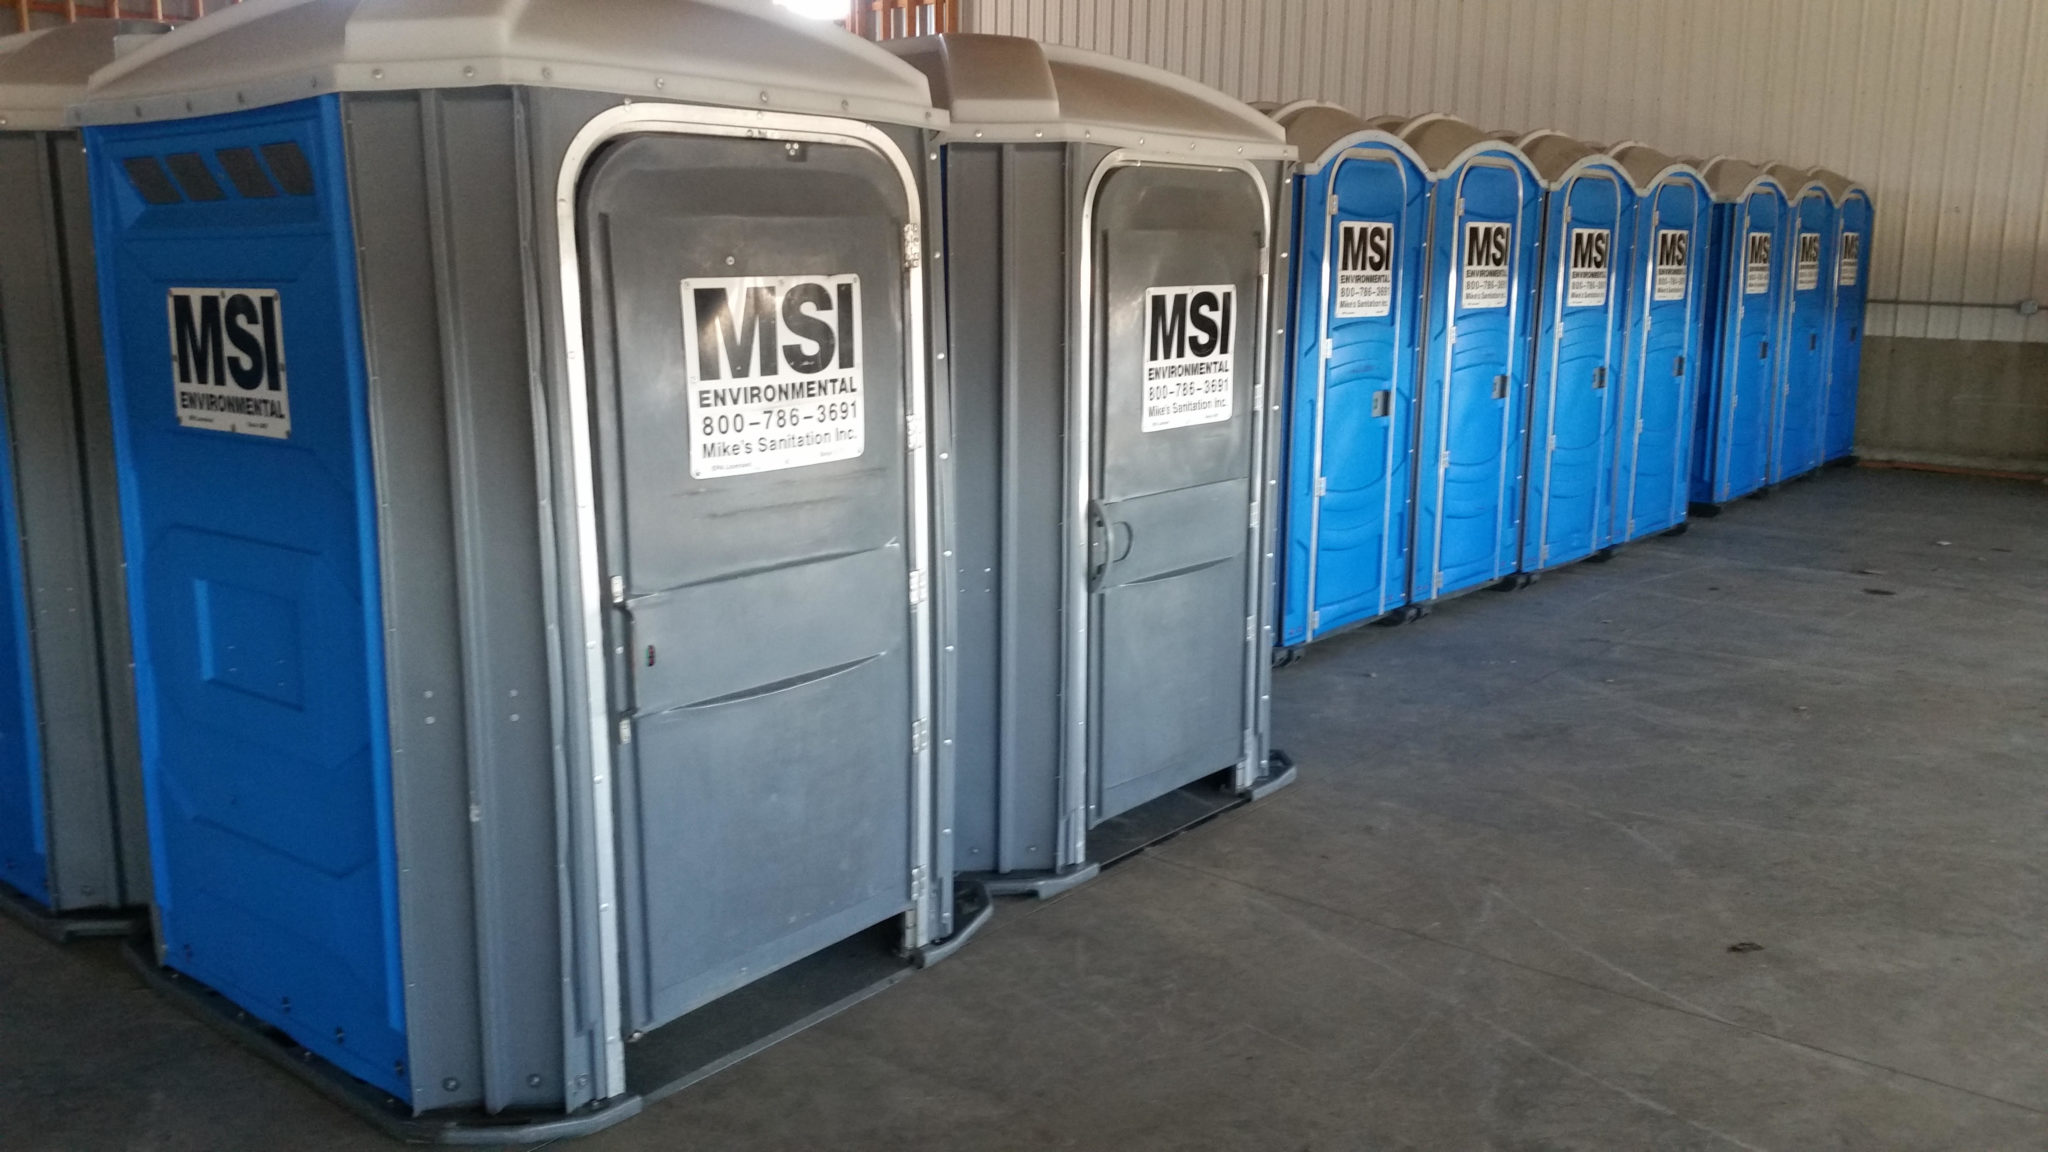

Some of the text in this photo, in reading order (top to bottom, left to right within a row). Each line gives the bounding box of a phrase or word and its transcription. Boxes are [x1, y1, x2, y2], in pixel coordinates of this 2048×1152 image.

[1342, 226, 1391, 271] MSI
[1468, 226, 1510, 266] MSI
[1574, 233, 1609, 268] MSI
[1340, 274, 1390, 284] ENVIRONMENTAL
[173, 294, 282, 391] MSI
[694, 283, 855, 381] MSI
[1150, 291, 1232, 361] MSI
[1148, 360, 1230, 381] ENVIRONMENTAL
[180, 392, 285, 419] ENVIRONMENTAL
[699, 376, 858, 408] ENVIRONMENTAL
[1148, 377, 1229, 401] 800-786-3691
[702, 400, 857, 436] 800-786-3691
[1148, 405, 1171, 418] Mike's
[1173, 399, 1212, 415] Sanitation
[702, 427, 858, 459] Mike's Sanitation Inc.
